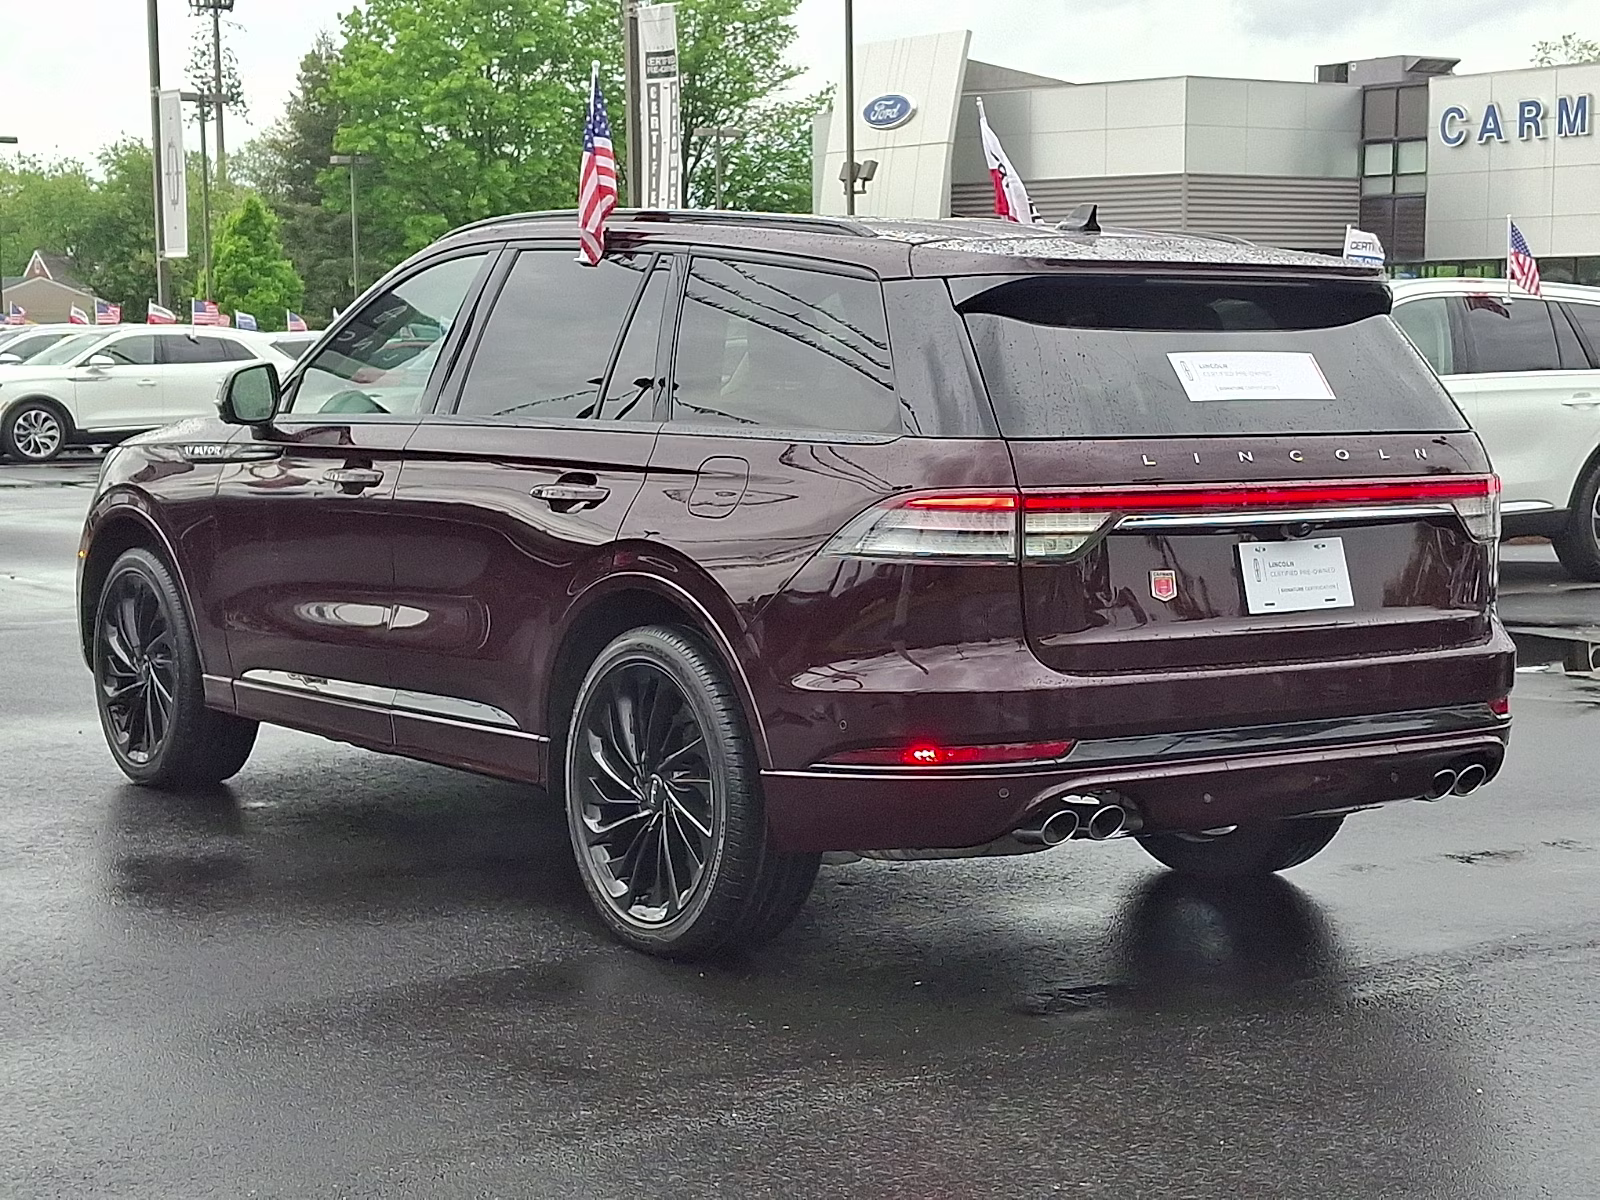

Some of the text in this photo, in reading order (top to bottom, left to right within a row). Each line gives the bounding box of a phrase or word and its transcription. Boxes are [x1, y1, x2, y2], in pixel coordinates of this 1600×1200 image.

[870, 100, 901, 121] Ford
[1439, 93, 1590, 147] CARM
[650, 86, 659, 209] CERTIFIE
[1142, 448, 1428, 466] LINCOLN
[1270, 570, 1298, 578] CERTIFIED
